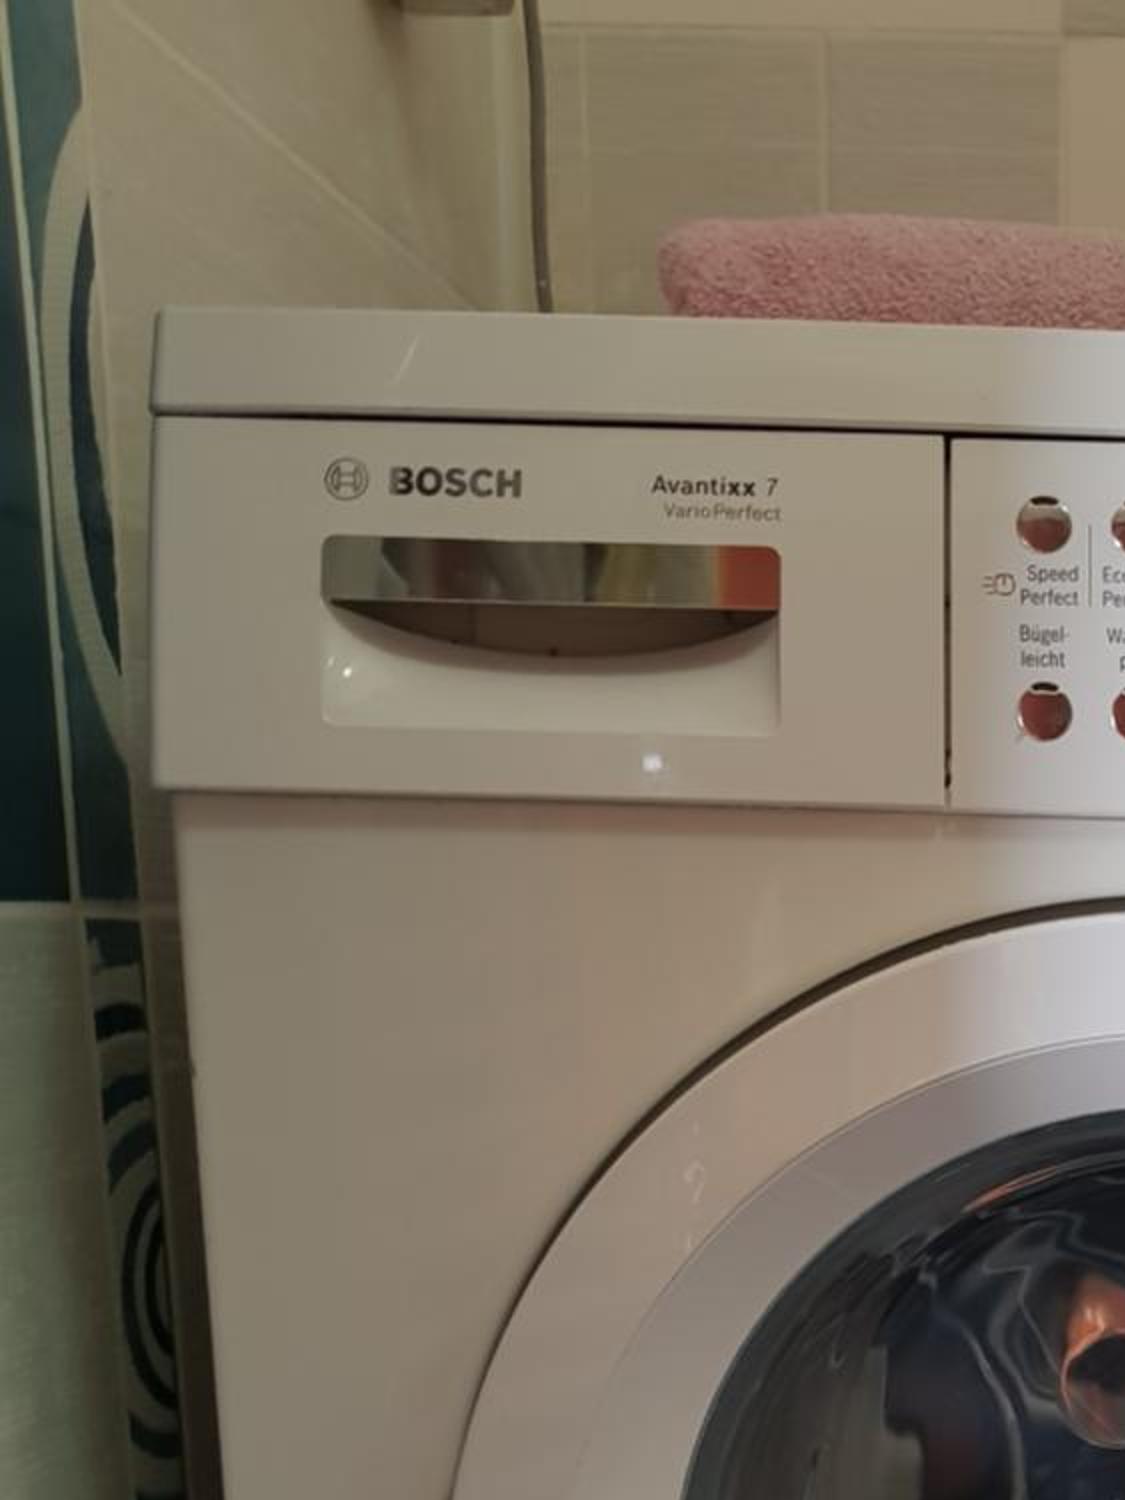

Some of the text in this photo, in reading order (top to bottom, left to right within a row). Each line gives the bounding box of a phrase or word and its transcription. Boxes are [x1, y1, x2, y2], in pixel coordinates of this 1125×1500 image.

[388, 466, 523, 499] BOSCH
[651, 474, 779, 497] Avantixx 7
[1026, 564, 1079, 584] Speed
[1020, 589, 1079, 606] Perfect
[1019, 623, 1068, 647] Bügel-
[1020, 651, 1066, 668] leicht
